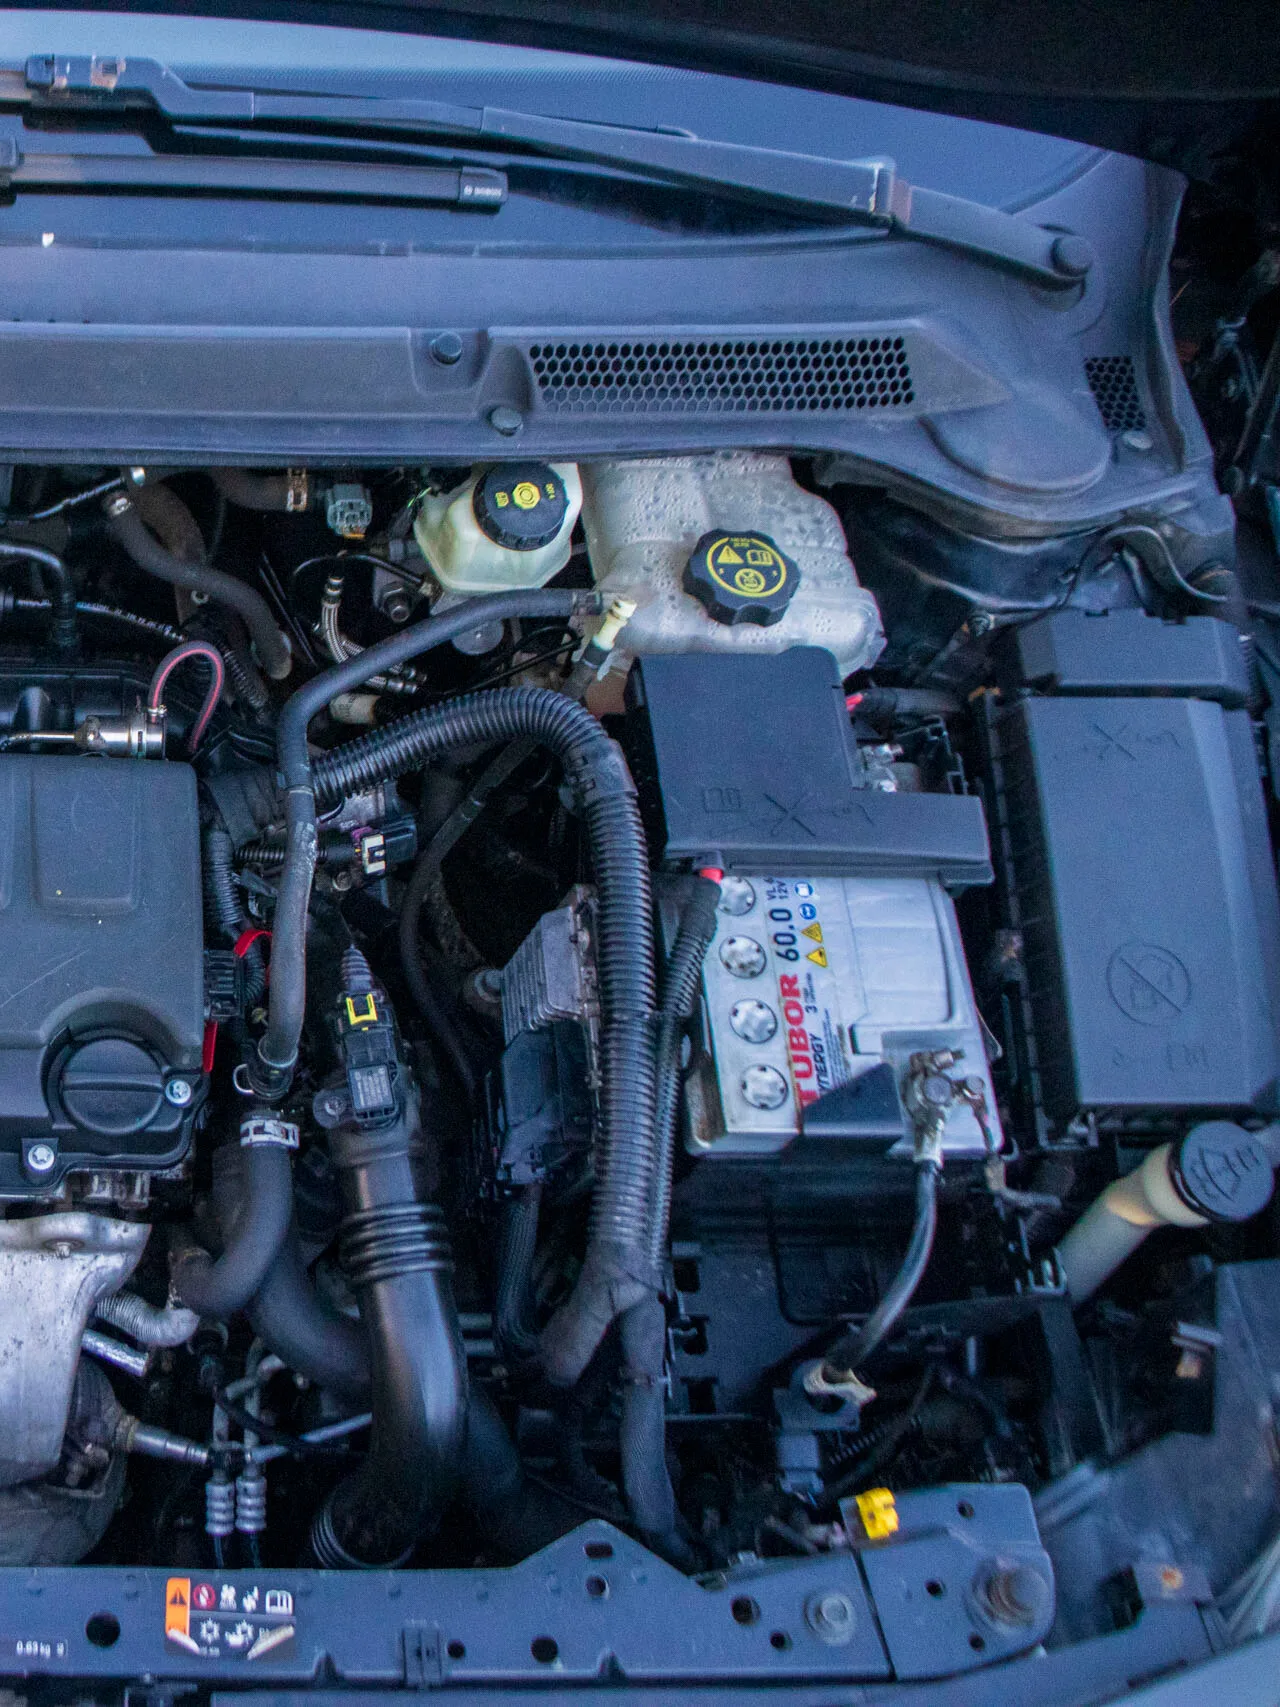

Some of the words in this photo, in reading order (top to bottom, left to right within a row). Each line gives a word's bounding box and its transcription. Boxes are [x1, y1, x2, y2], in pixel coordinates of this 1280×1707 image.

[769, 908, 800, 962] 60.0
[780, 973, 819, 1109] TUBOR
[810, 1033, 832, 1093] YNERGY
